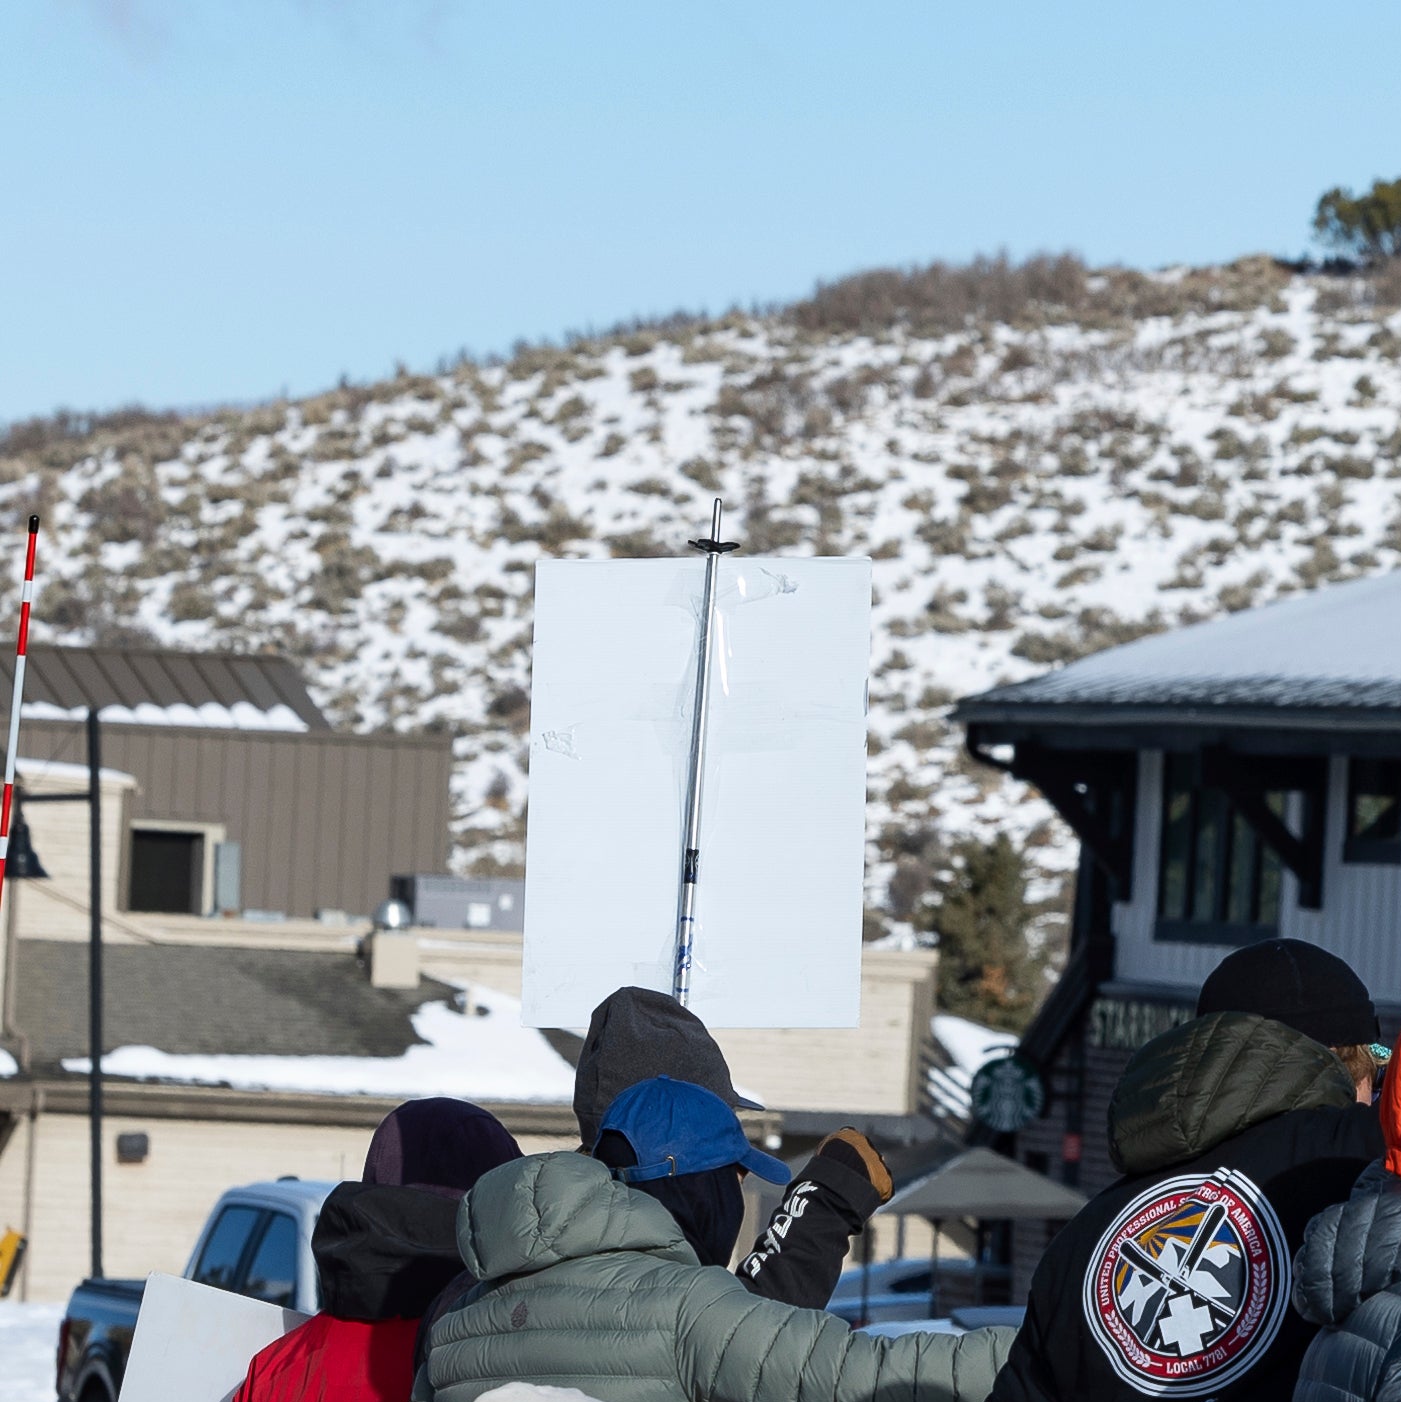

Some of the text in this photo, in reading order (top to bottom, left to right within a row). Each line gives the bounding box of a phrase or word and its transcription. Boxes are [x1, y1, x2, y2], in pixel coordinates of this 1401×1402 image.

[1220, 1194, 1263, 1258] OF AMERICA
[1100, 1261, 1112, 1306] UNITED
[1166, 1346, 1228, 1375] LOCAL 7781
